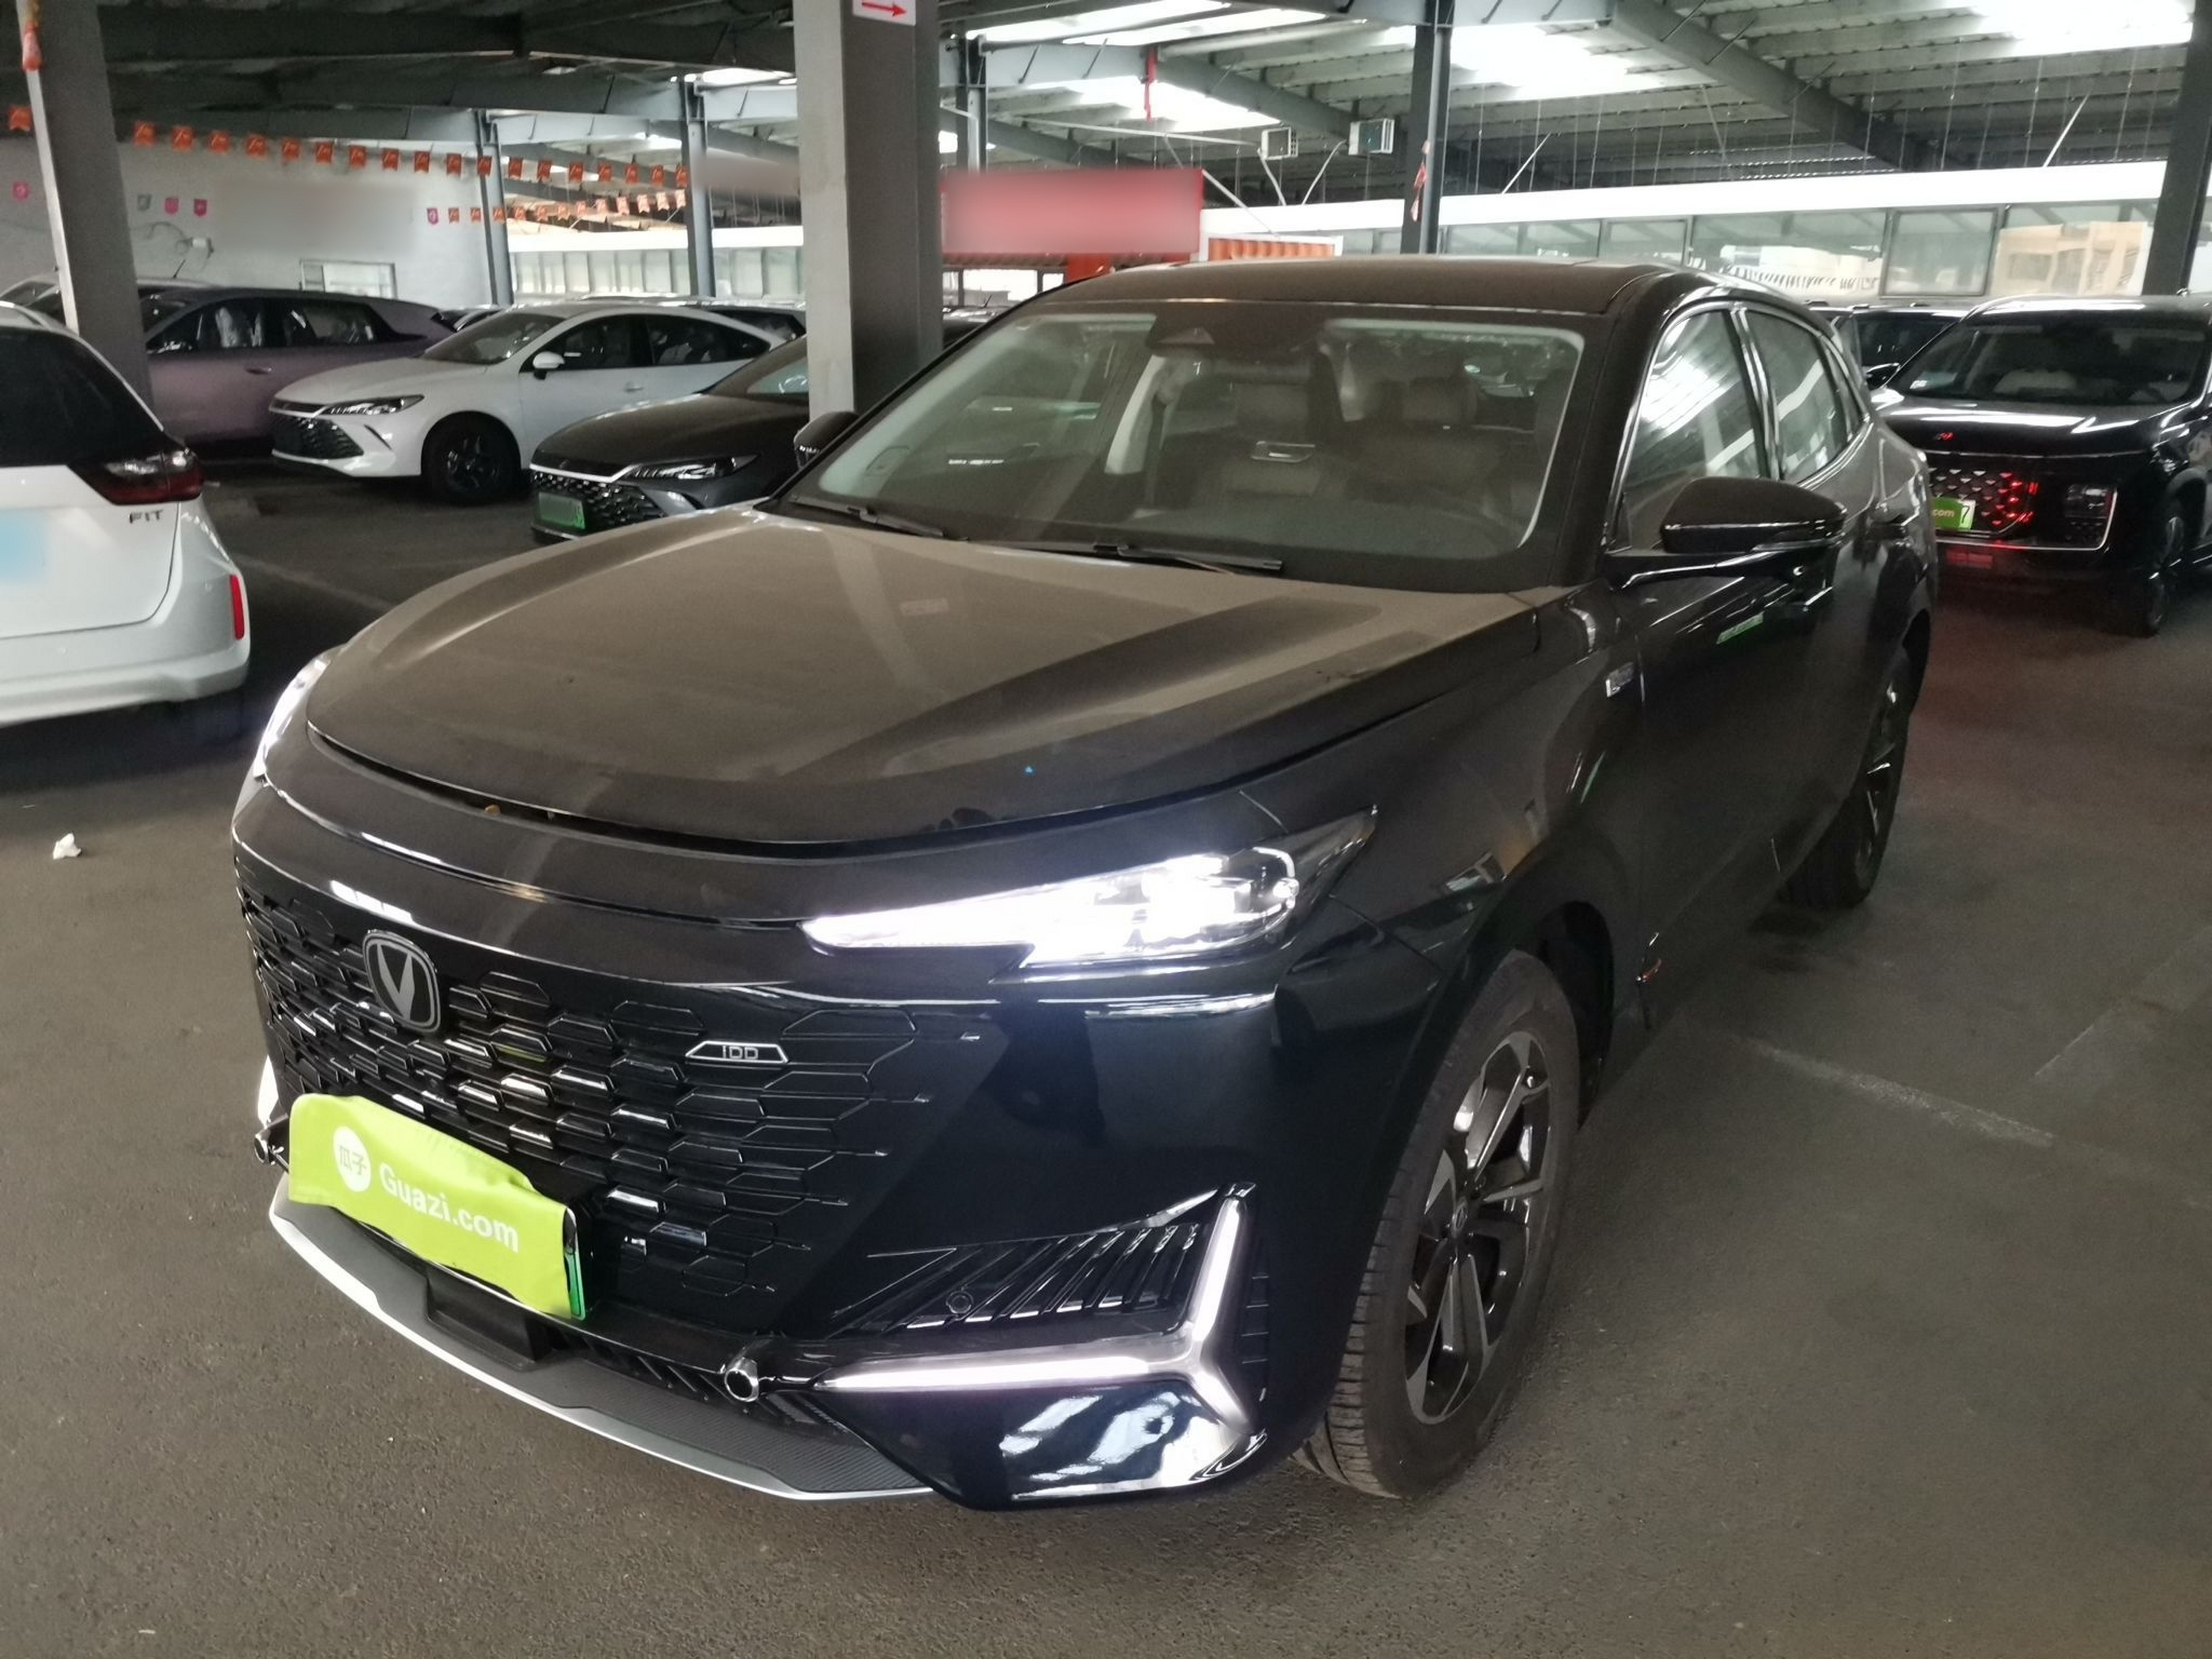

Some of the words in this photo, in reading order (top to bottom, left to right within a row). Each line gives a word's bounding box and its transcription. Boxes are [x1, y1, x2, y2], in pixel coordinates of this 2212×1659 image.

[130, 509, 164, 524] FIT
[722, 1045, 759, 1060] IDD
[339, 1145, 367, 1176] 瓜子
[380, 1162, 518, 1253] Guazi.com
